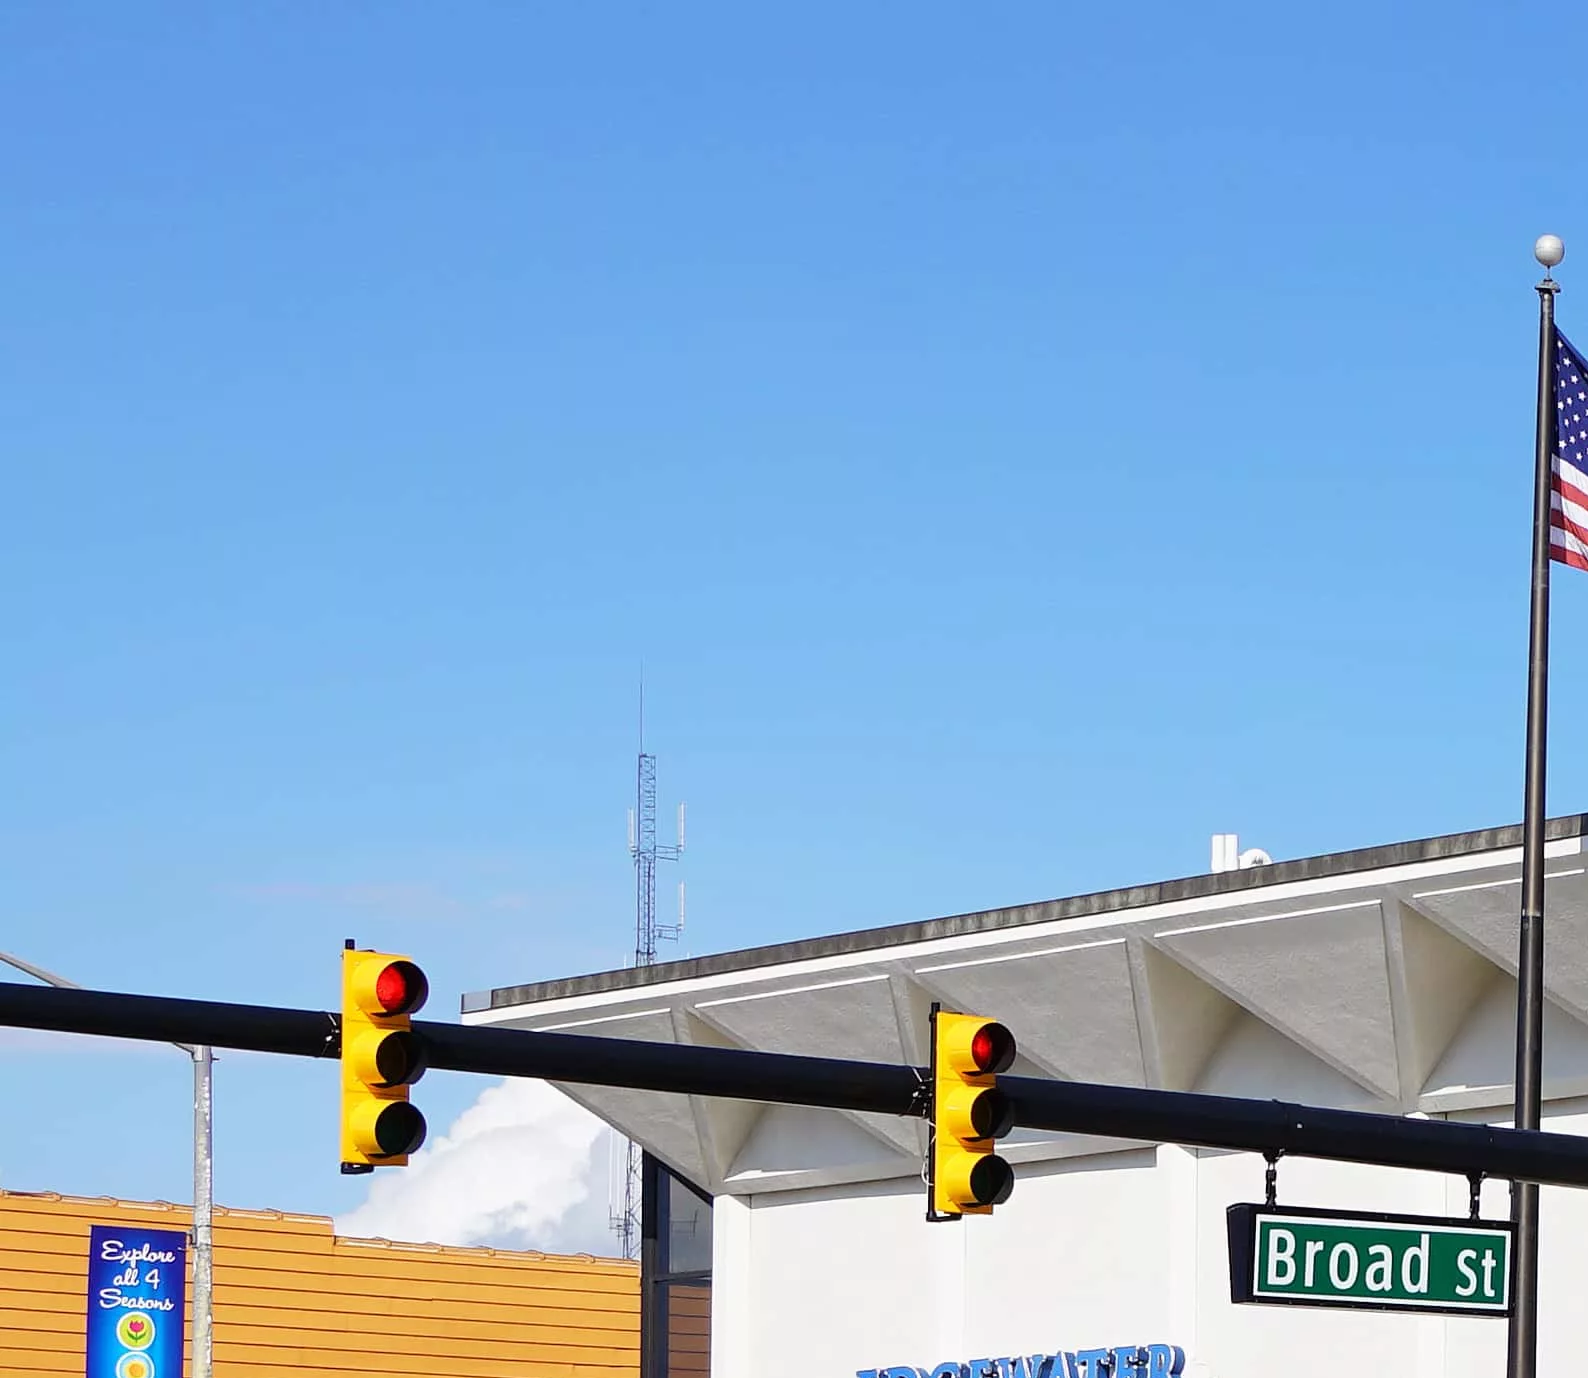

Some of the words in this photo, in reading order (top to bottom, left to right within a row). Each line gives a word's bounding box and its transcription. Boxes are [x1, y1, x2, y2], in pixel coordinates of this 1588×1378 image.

[101, 1240, 175, 1268] Explore
[1267, 1229, 1430, 1293] Broad
[1455, 1249, 1497, 1297] St
[113, 1268, 140, 1286] all
[145, 1269, 160, 1290] 4
[99, 1288, 174, 1311] Seasons
